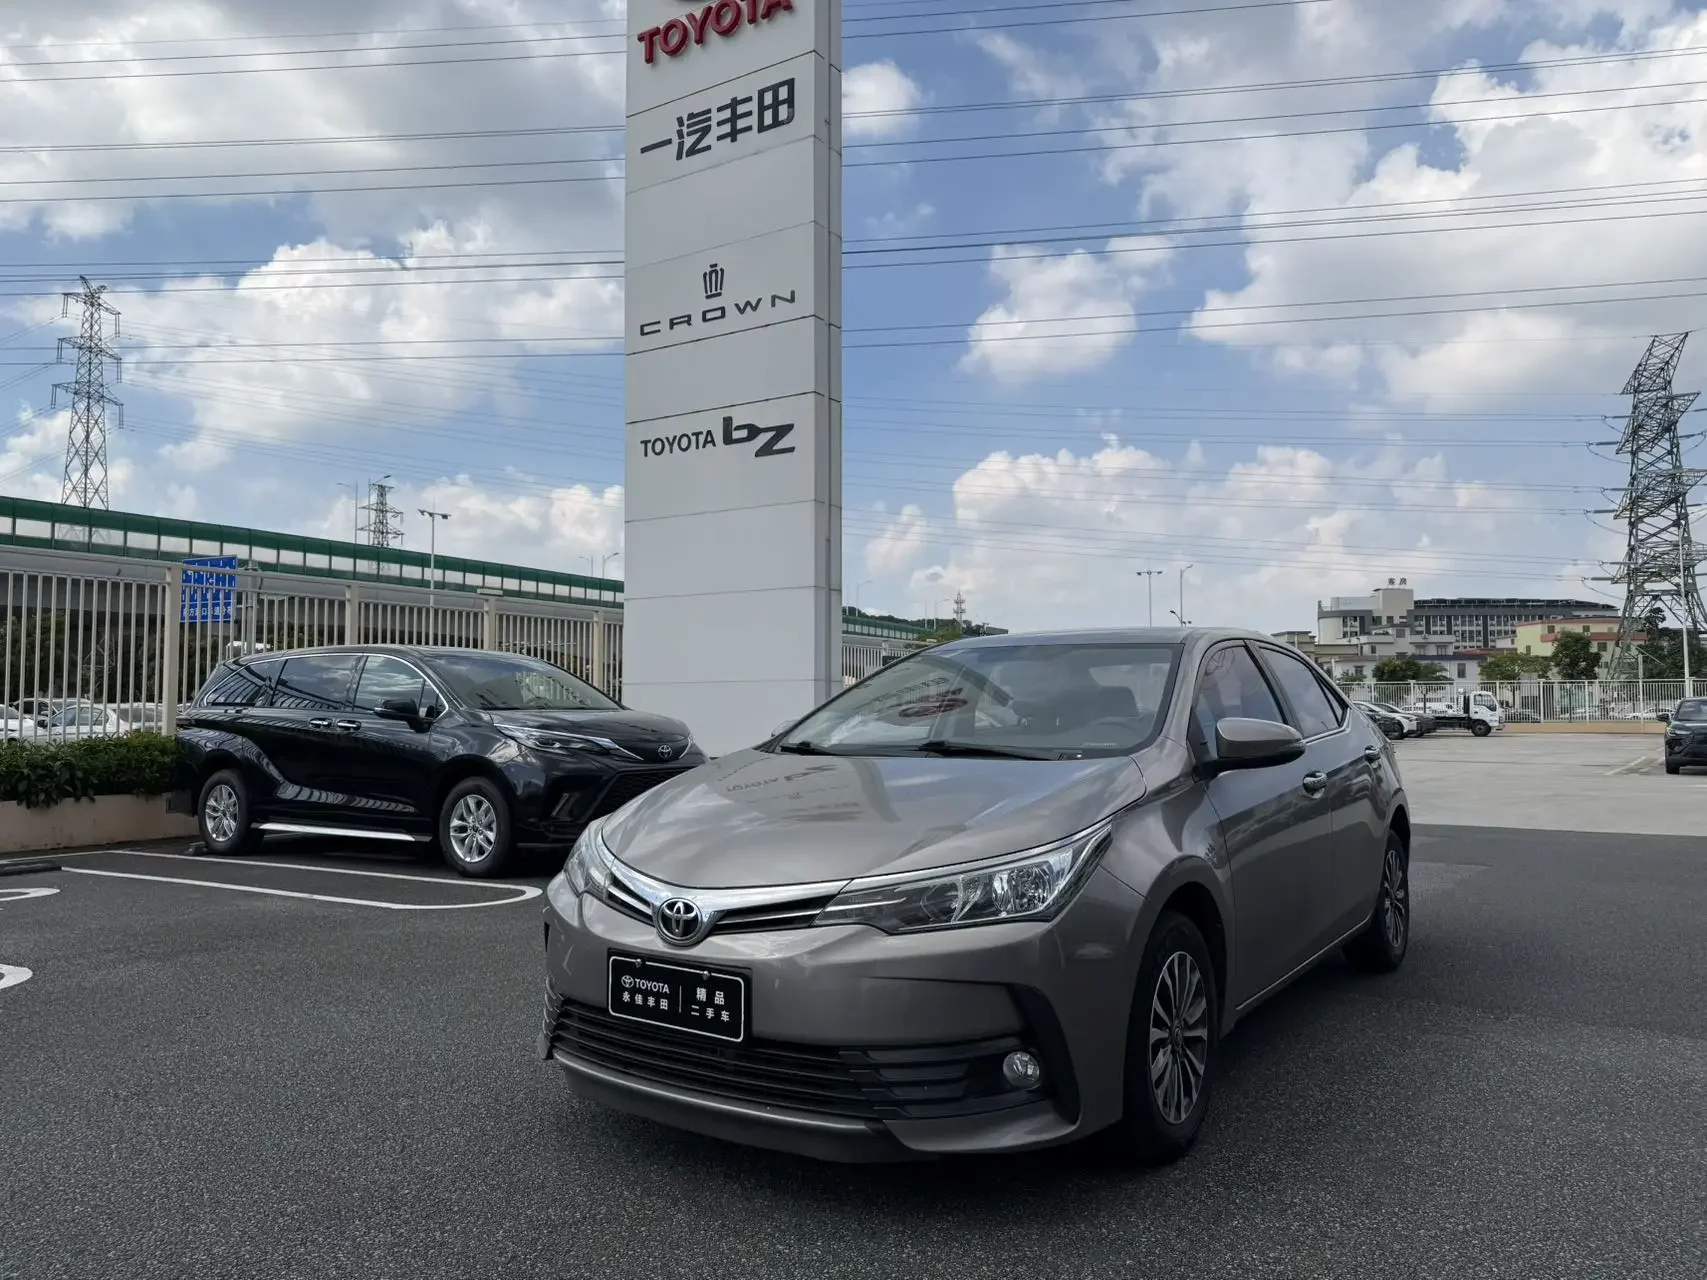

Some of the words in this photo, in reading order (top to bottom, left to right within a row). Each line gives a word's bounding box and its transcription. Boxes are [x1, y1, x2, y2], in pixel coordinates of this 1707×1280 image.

[640, 77, 795, 161] 一汽丰田
[640, 289, 796, 336] CROWN
[640, 429, 717, 458] TOYOTA
[634, 978, 670, 994] TOYOTA
[696, 986, 725, 1006] 精品
[622, 990, 668, 1011] 永佳丰田
[691, 1004, 730, 1023] 二手车
